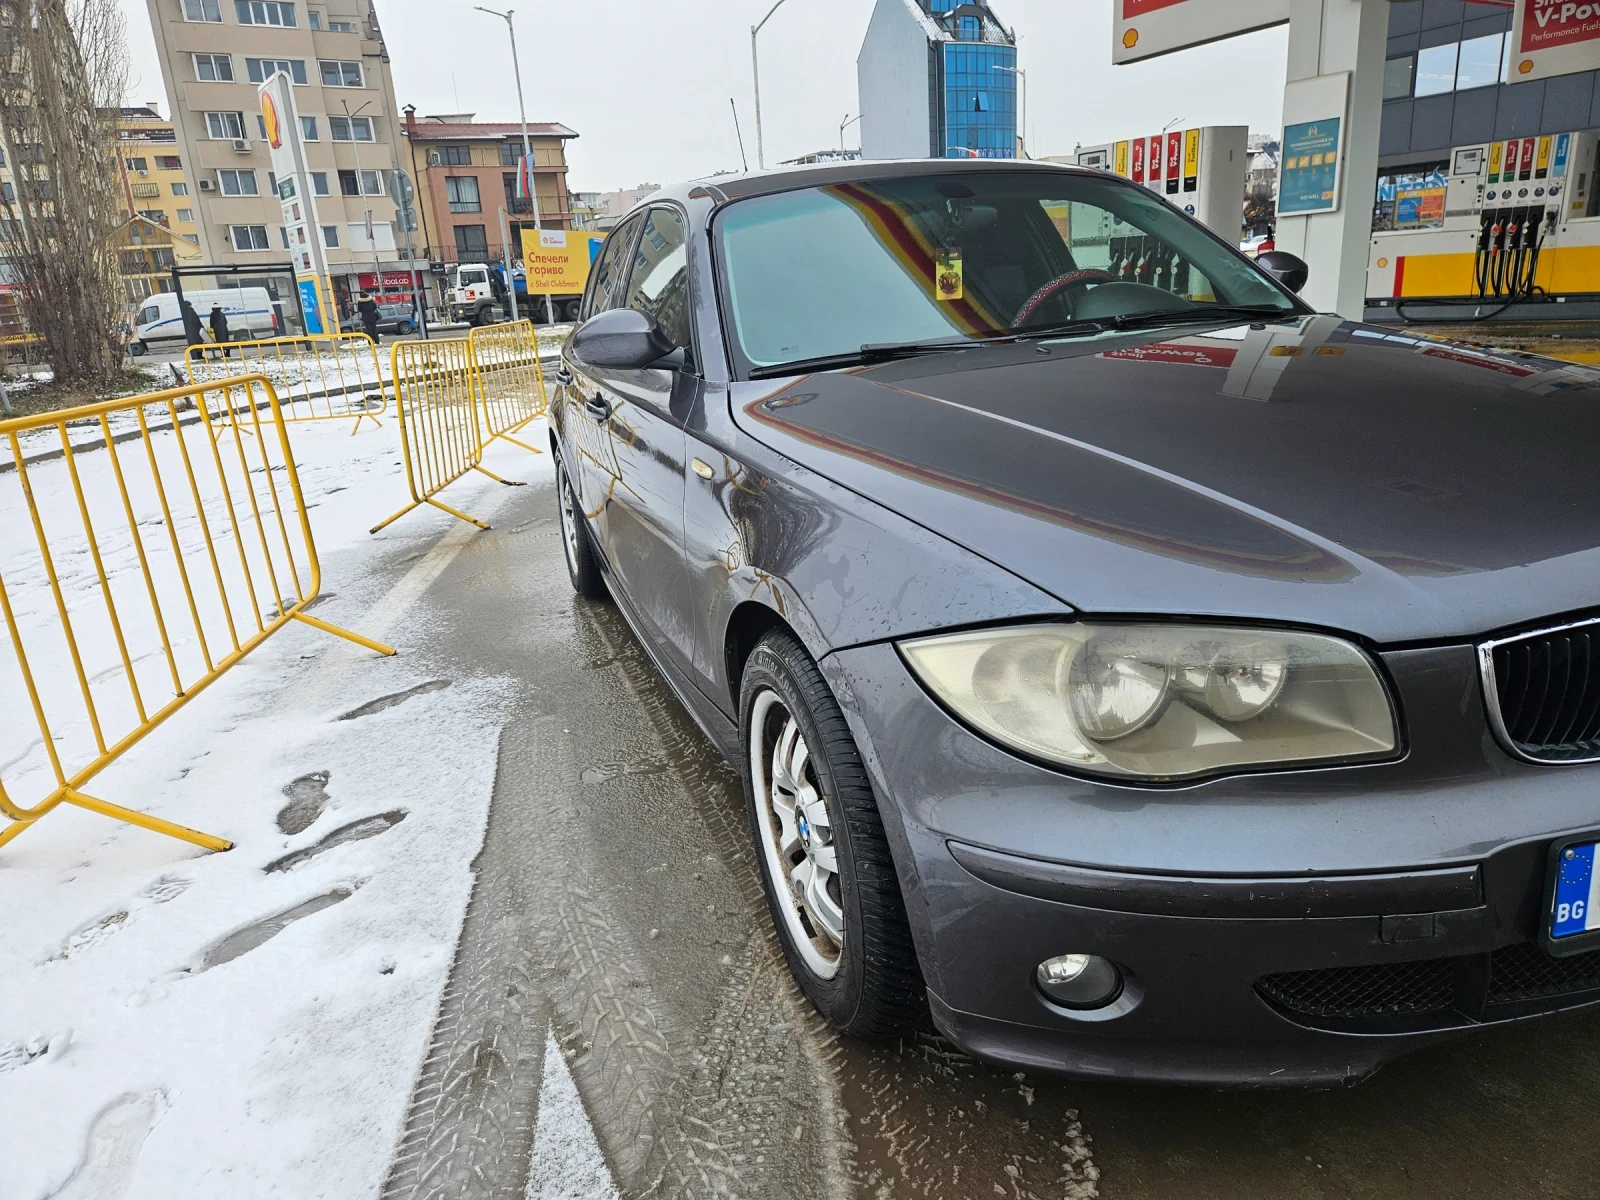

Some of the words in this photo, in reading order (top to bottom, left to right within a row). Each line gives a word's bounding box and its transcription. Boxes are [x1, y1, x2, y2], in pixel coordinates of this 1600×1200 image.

[1531, 28, 1580, 42] Performance
[528, 252, 569, 263] Спечели
[529, 266, 564, 277] гориво
[535, 280, 550, 288] Shell
[550, 279, 579, 288] ClubSmart
[1557, 900, 1584, 923] BG
